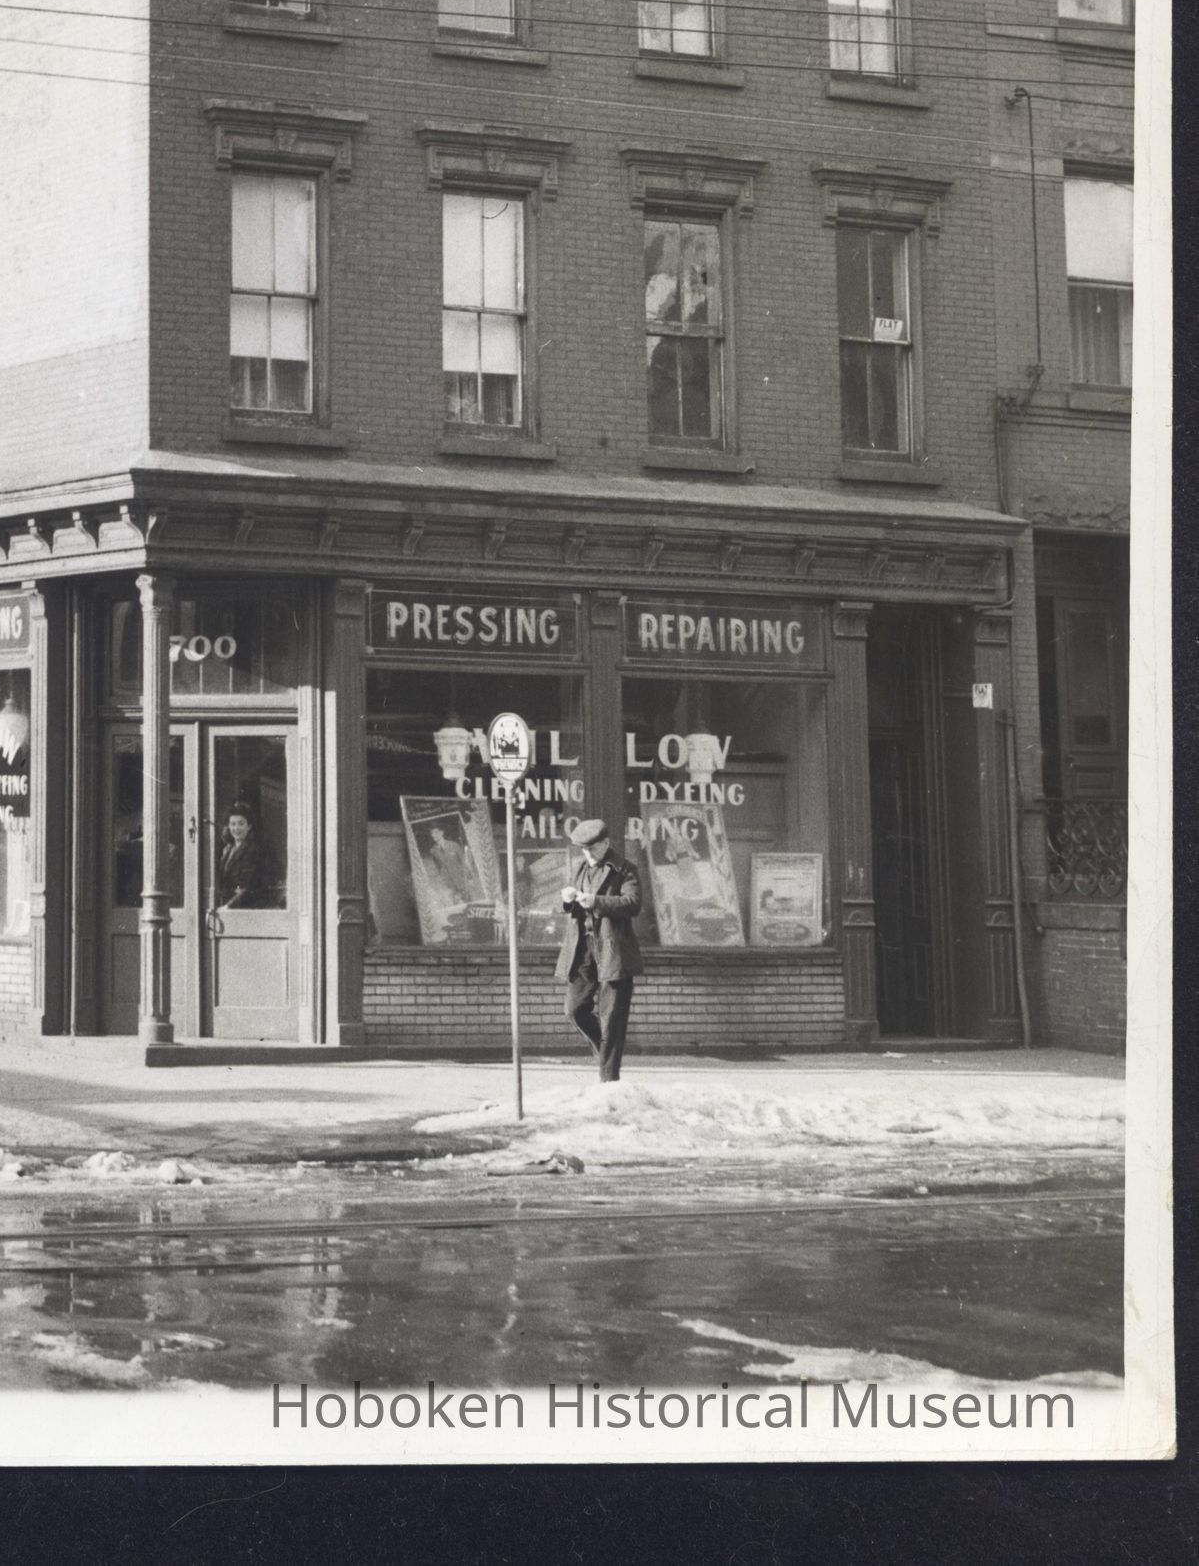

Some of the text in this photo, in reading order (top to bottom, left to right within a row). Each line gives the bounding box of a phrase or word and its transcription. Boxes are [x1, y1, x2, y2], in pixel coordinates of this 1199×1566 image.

[386, 601, 560, 645] PRESSING
[639, 612, 805, 655] REPAIRING
[168, 635, 237, 662] 700
[455, 776, 585, 803] CLENING
